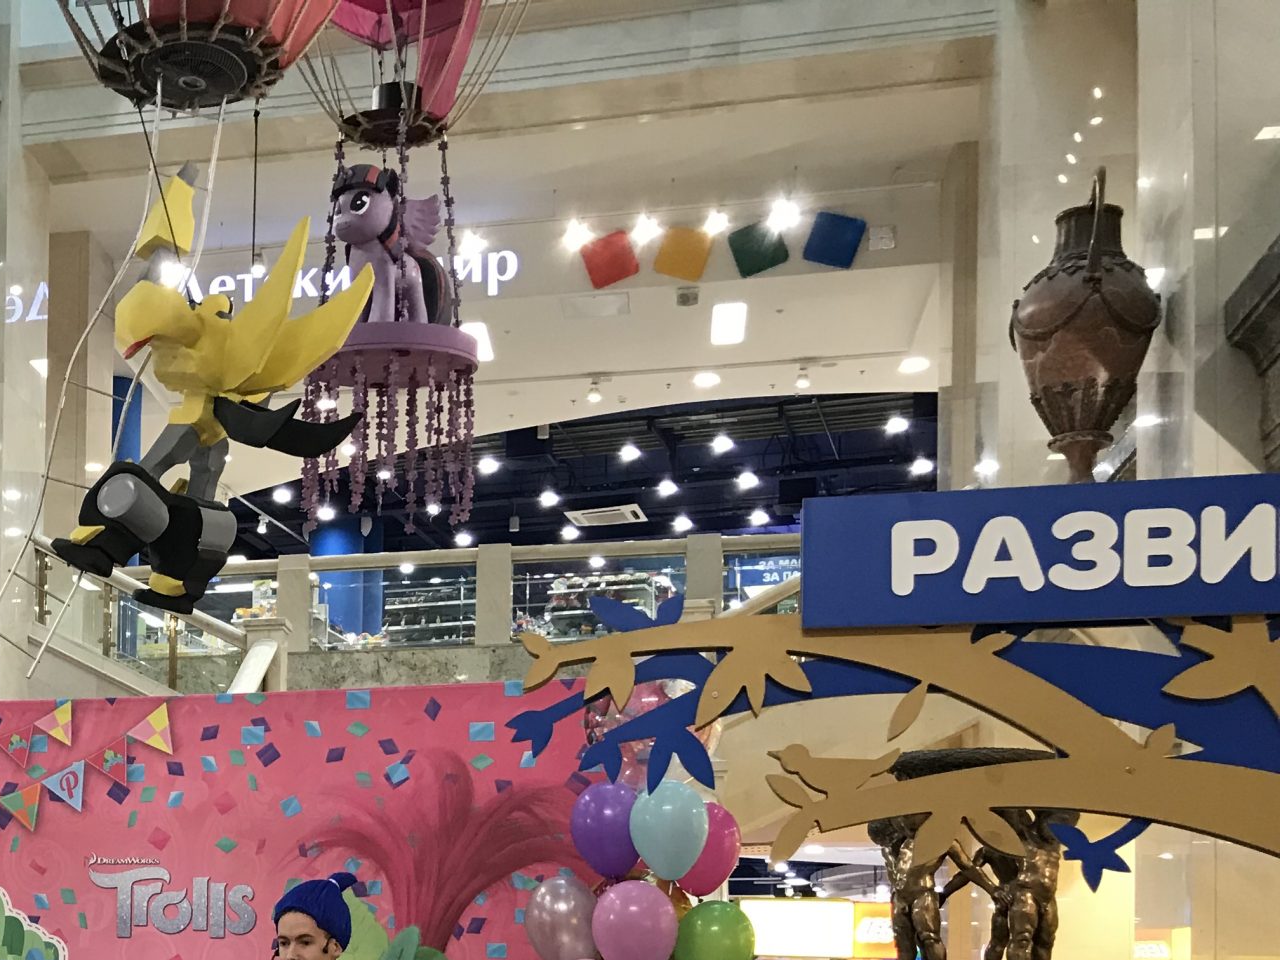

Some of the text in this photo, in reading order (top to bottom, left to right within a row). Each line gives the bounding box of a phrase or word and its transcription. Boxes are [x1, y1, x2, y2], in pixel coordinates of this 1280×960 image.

[437, 248, 518, 296] ир
[763, 571, 780, 582] ЗА
[891, 502, 1276, 597] РАЗВИ
[89, 866, 257, 939] Trolls
